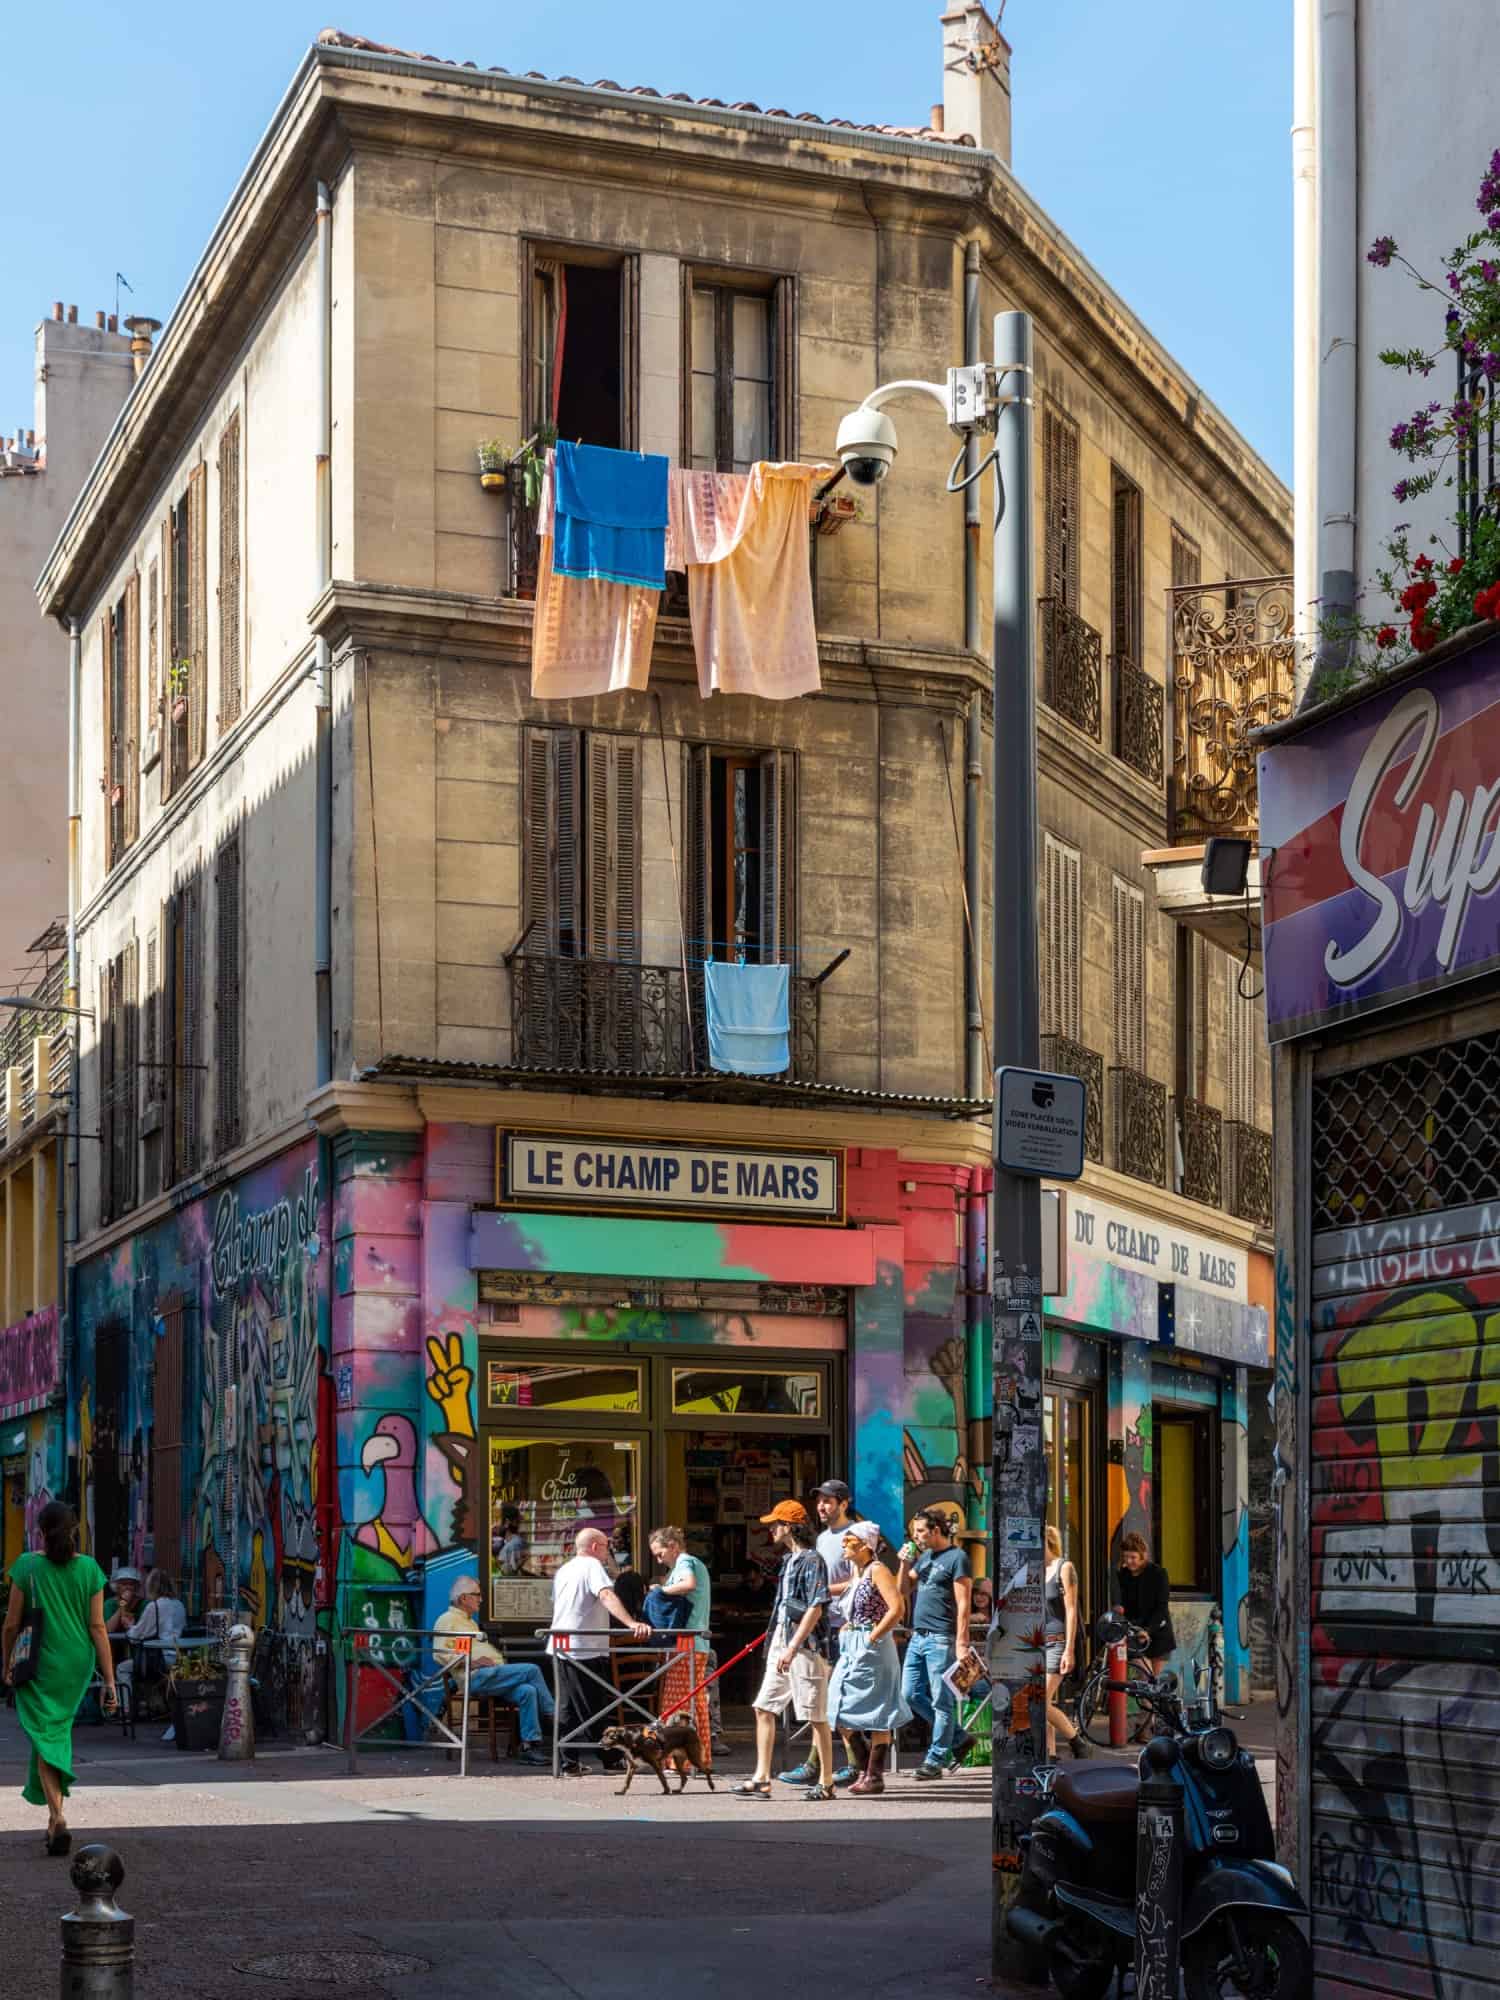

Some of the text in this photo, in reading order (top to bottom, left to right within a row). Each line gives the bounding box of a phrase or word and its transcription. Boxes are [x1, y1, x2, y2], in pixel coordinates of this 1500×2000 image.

[526, 1149, 819, 1201] LE CHAMP DE MARS
[1074, 1210, 1237, 1289] DU CHAMP DE MARS
[541, 1480, 588, 1502] Champ
[554, 1457, 577, 1485] Le
